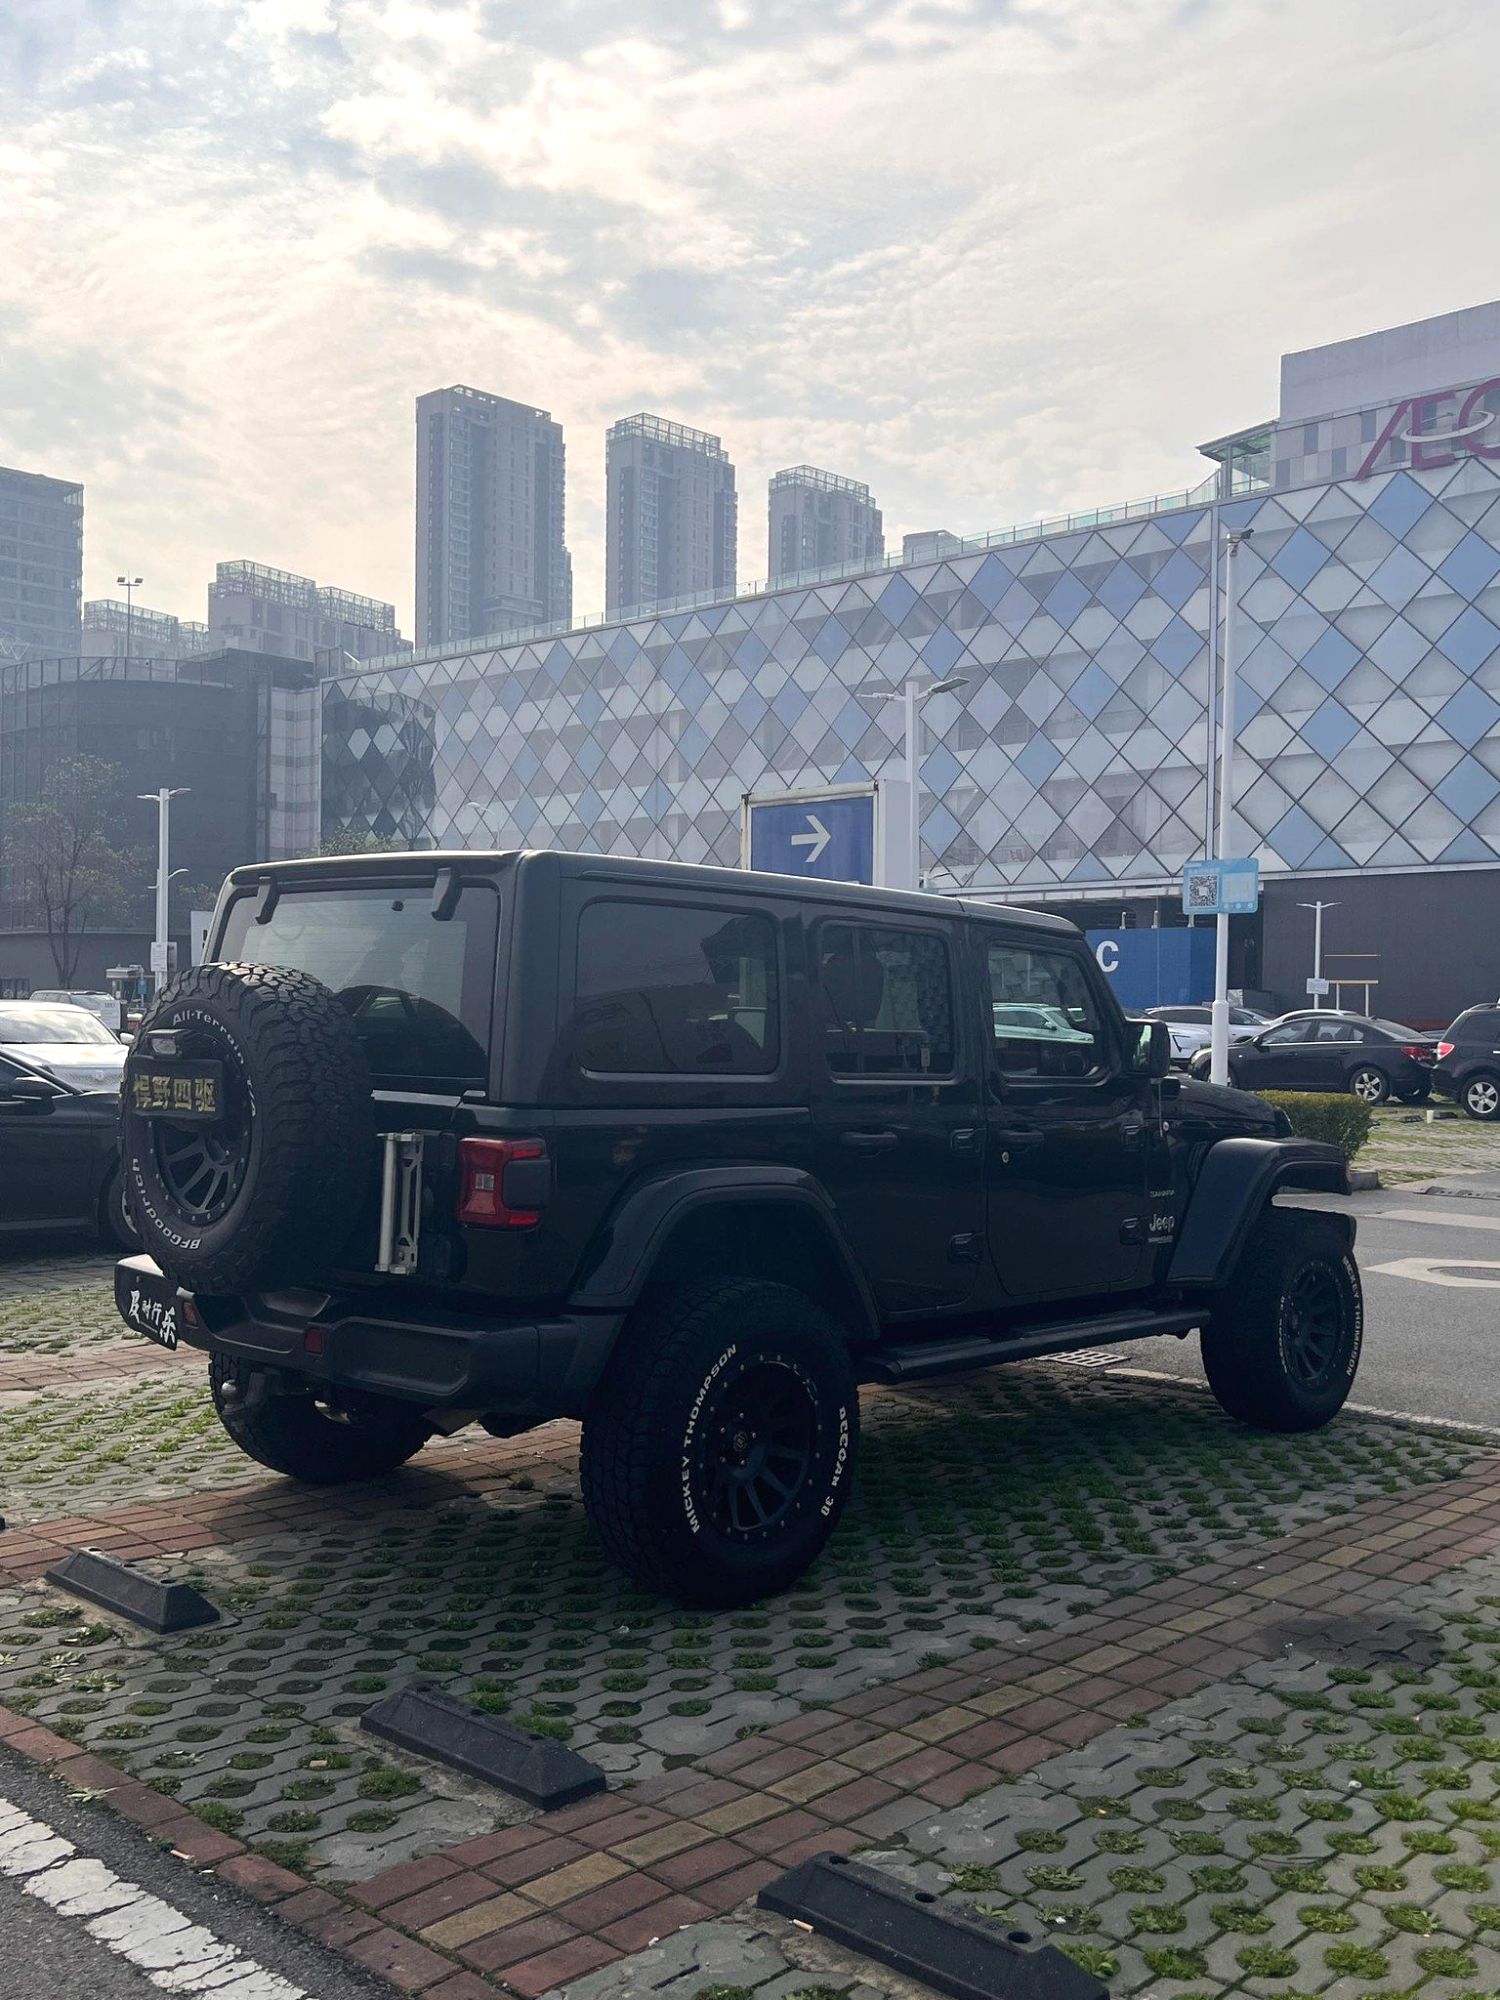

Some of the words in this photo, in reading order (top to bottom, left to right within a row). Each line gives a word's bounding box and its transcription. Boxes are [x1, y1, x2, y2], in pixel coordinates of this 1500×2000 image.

[1096, 940, 1120, 973] C
[132, 1158, 202, 1249] BFGoodrich
[1149, 1213, 1175, 1233] Jeep
[684, 1343, 737, 1449] THOMPSON
[681, 1455, 703, 1534] MICKEY
